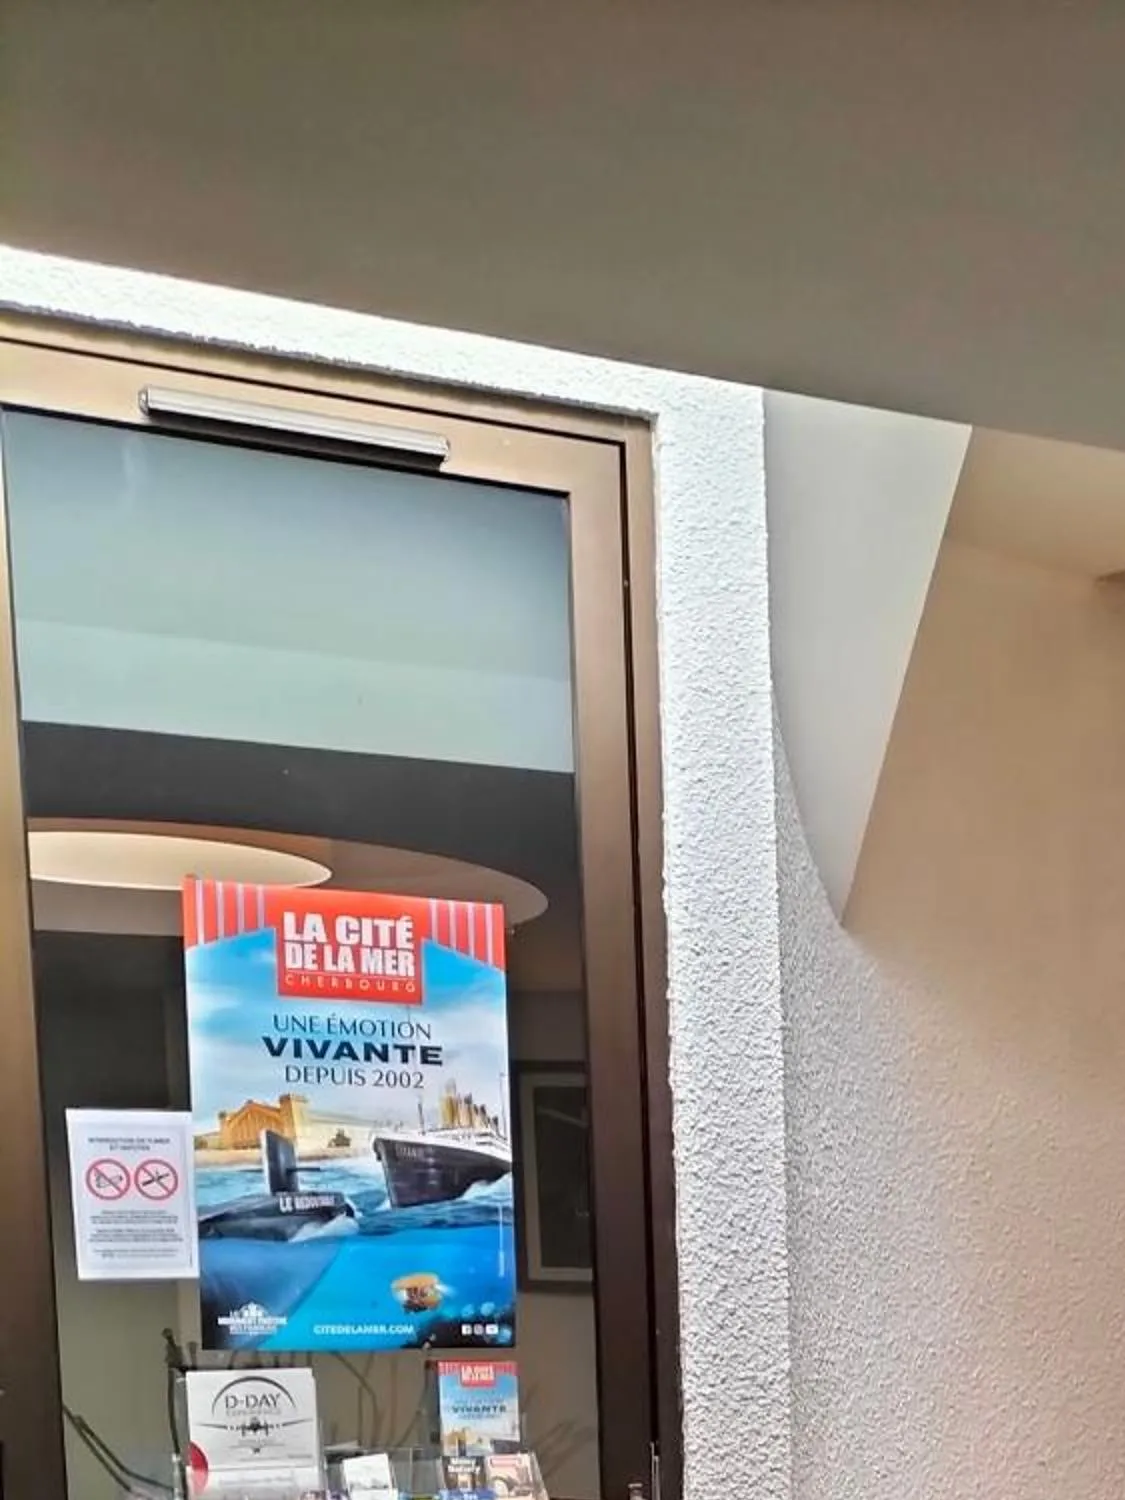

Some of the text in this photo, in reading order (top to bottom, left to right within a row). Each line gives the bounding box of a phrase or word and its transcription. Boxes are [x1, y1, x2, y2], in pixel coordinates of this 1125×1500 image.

[283, 911, 414, 949] LA CITÉ
[285, 942, 415, 977] DE LA MER
[285, 974, 415, 993] CHERBOURG
[273, 1012, 431, 1040] UNE ÉMOTION
[262, 1036, 443, 1066] VIVANTE
[285, 1064, 424, 1089] DEPUIS 2002
[225, 1393, 281, 1409] D-DAY
